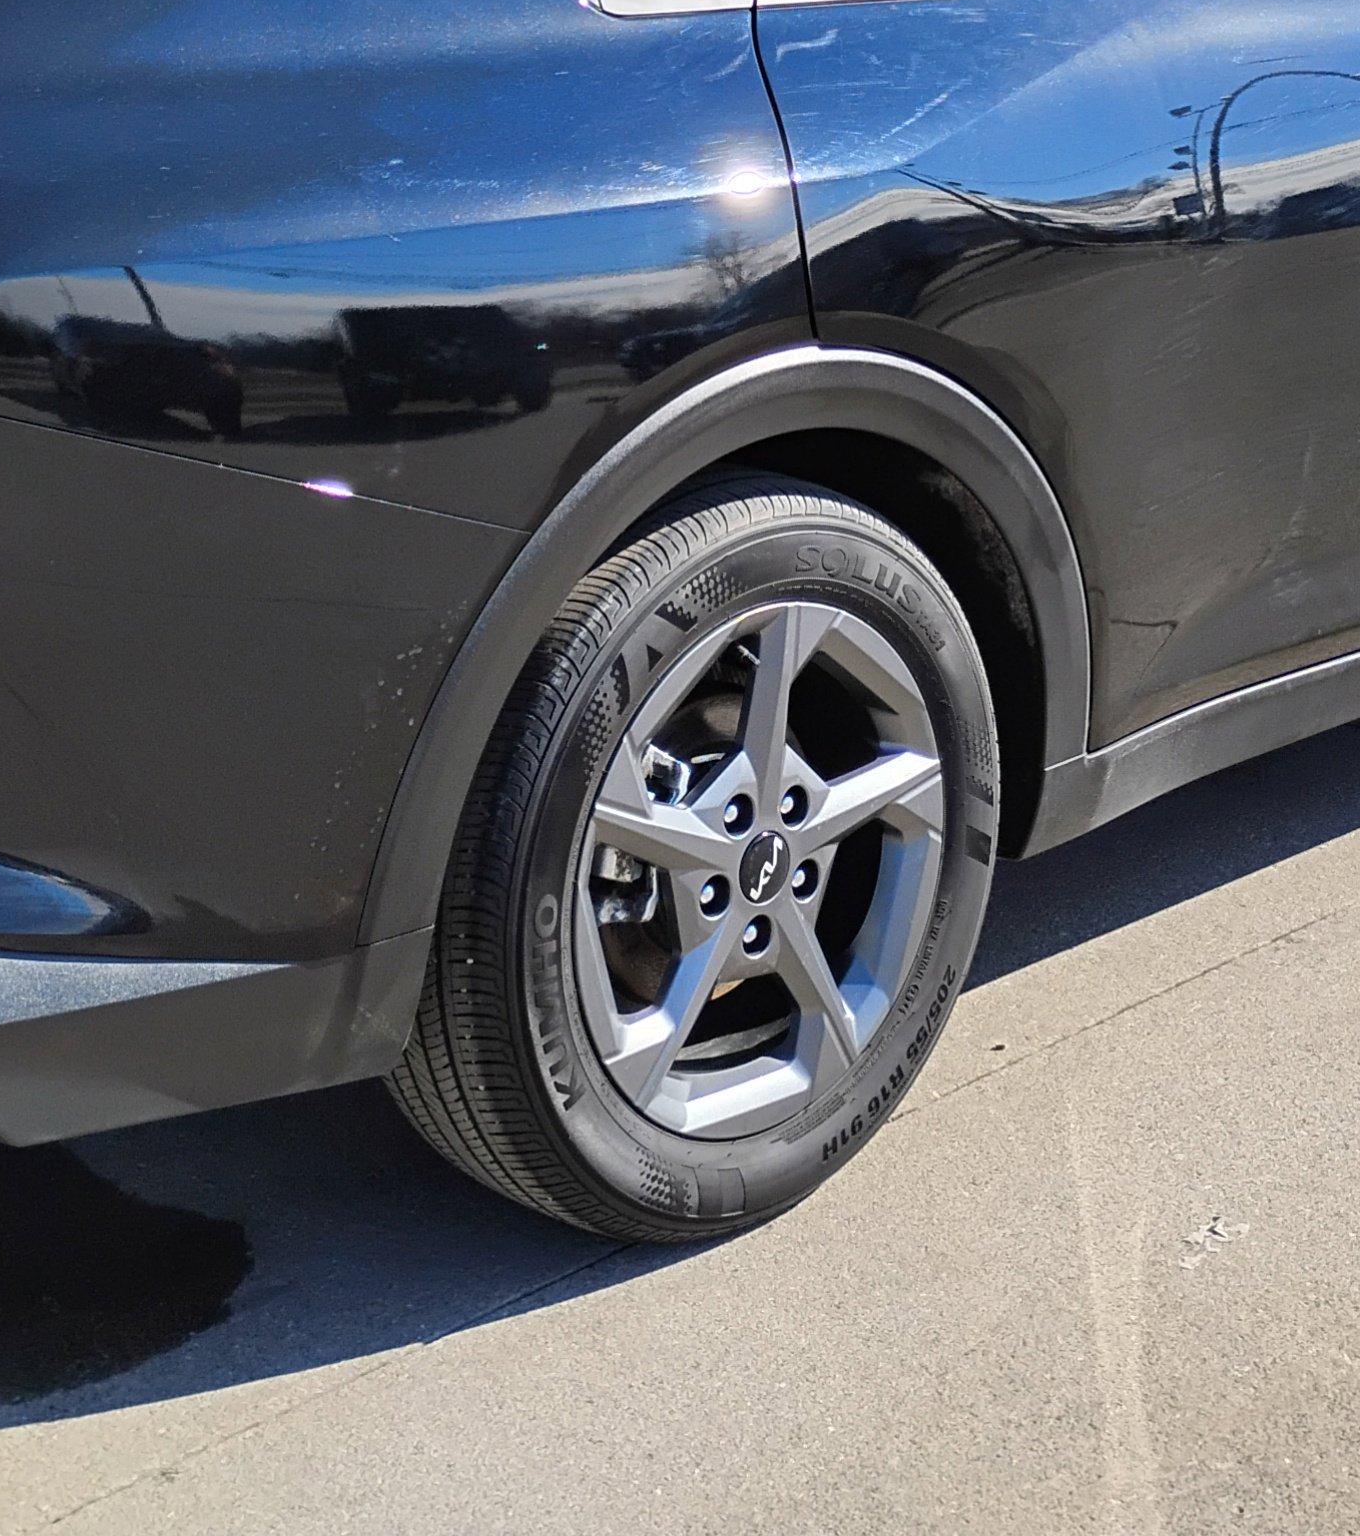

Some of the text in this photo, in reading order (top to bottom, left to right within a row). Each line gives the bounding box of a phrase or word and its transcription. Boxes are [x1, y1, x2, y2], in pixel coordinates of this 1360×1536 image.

[795, 545, 922, 614] SOLUS
[534, 893, 588, 1112] KUMHO
[906, 964, 956, 1064] 205/55
[867, 1064, 905, 1115] R16
[821, 1114, 865, 1162] 91H
